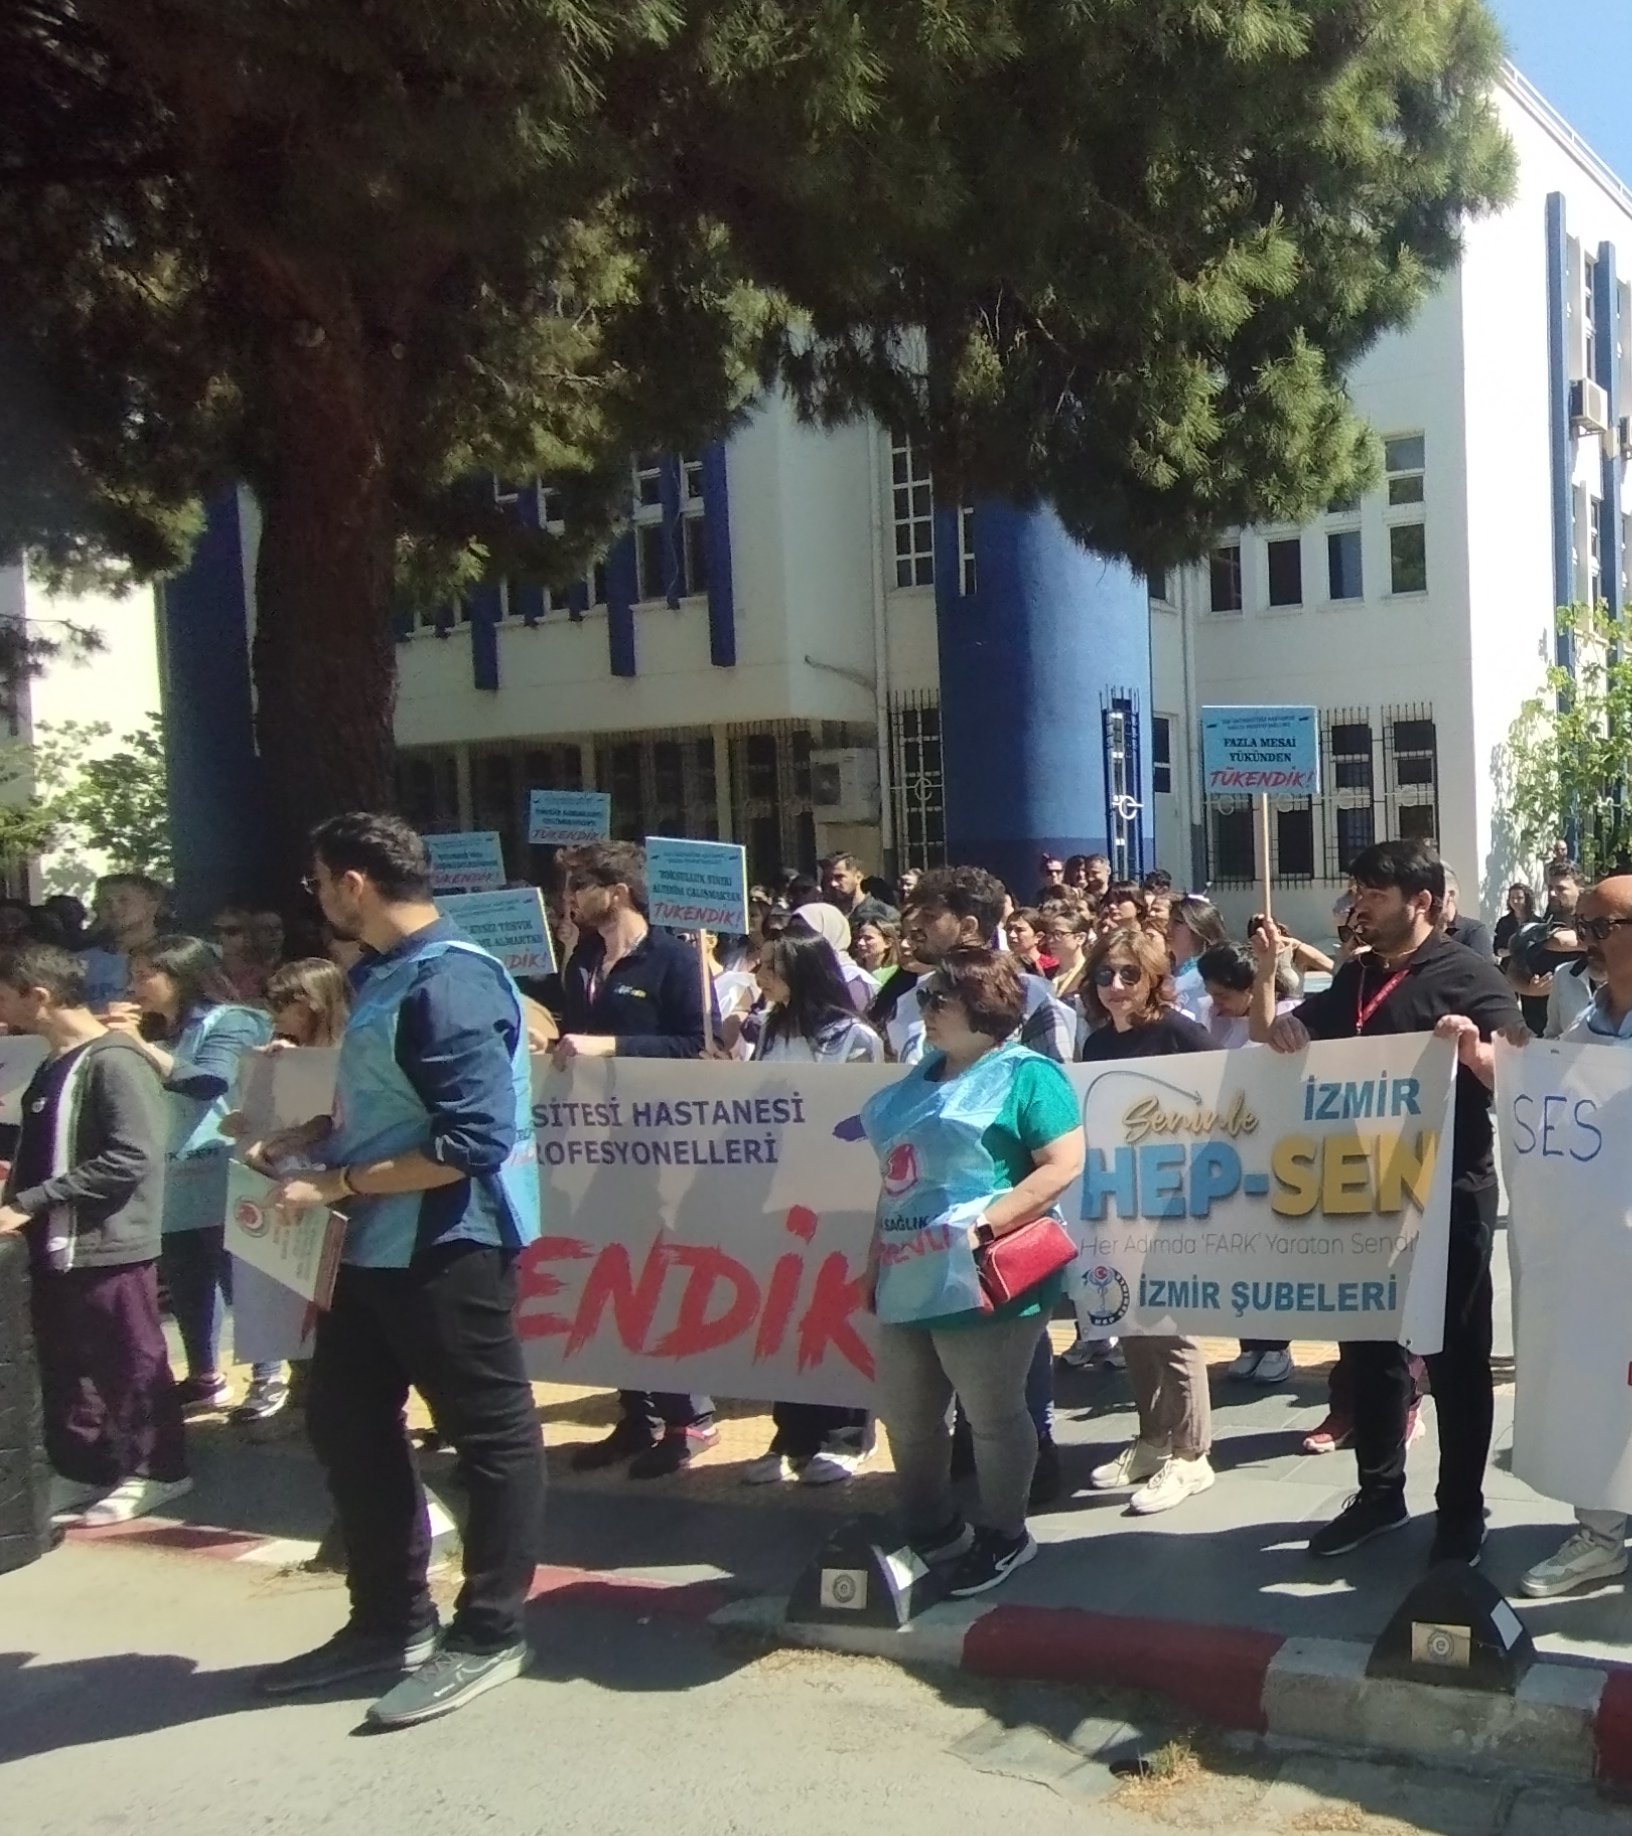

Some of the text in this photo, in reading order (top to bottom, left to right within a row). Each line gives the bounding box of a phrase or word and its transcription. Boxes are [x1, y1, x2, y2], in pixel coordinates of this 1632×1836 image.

[1223, 736, 1297, 748] FAZLA MESAİ
[1228, 750, 1292, 762] YÜKÜNDEN
[1210, 766, 1315, 788] TÜKENDİK!
[532, 1091, 806, 1129] SİTESİ HASTANESİ
[1303, 1070, 1422, 1122] İZMİR
[1512, 1093, 1603, 1163] SES
[1080, 1129, 1441, 1222] HEP-SEN
[1139, 1273, 1221, 1310] İZMİR
[1230, 1273, 1398, 1318] ŞUBELERİ
